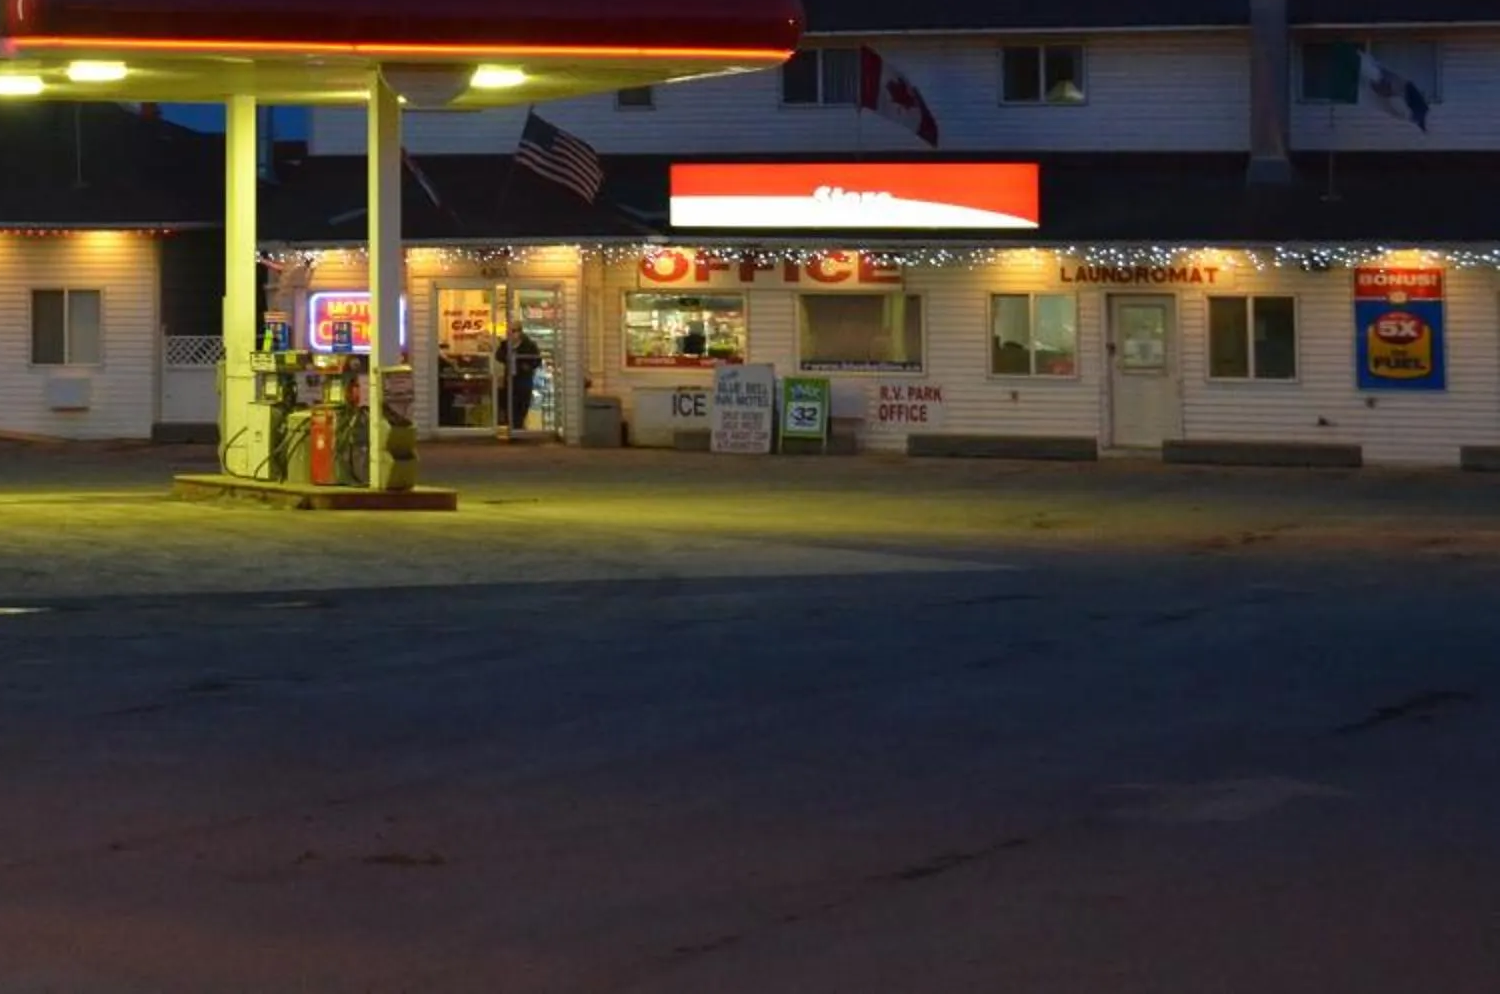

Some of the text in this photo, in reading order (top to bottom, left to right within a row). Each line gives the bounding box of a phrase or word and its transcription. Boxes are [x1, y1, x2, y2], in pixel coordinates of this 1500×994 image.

[640, 249, 902, 283] OFFICE
[1061, 267, 1219, 283] LAUNDROMAT
[1360, 274, 1437, 286] BONUS!
[327, 301, 372, 317] MOT
[1379, 320, 1419, 337] 5X
[880, 386, 942, 402] R.V. PARK
[672, 394, 706, 417] ICE
[879, 405, 927, 422] OFFICE
